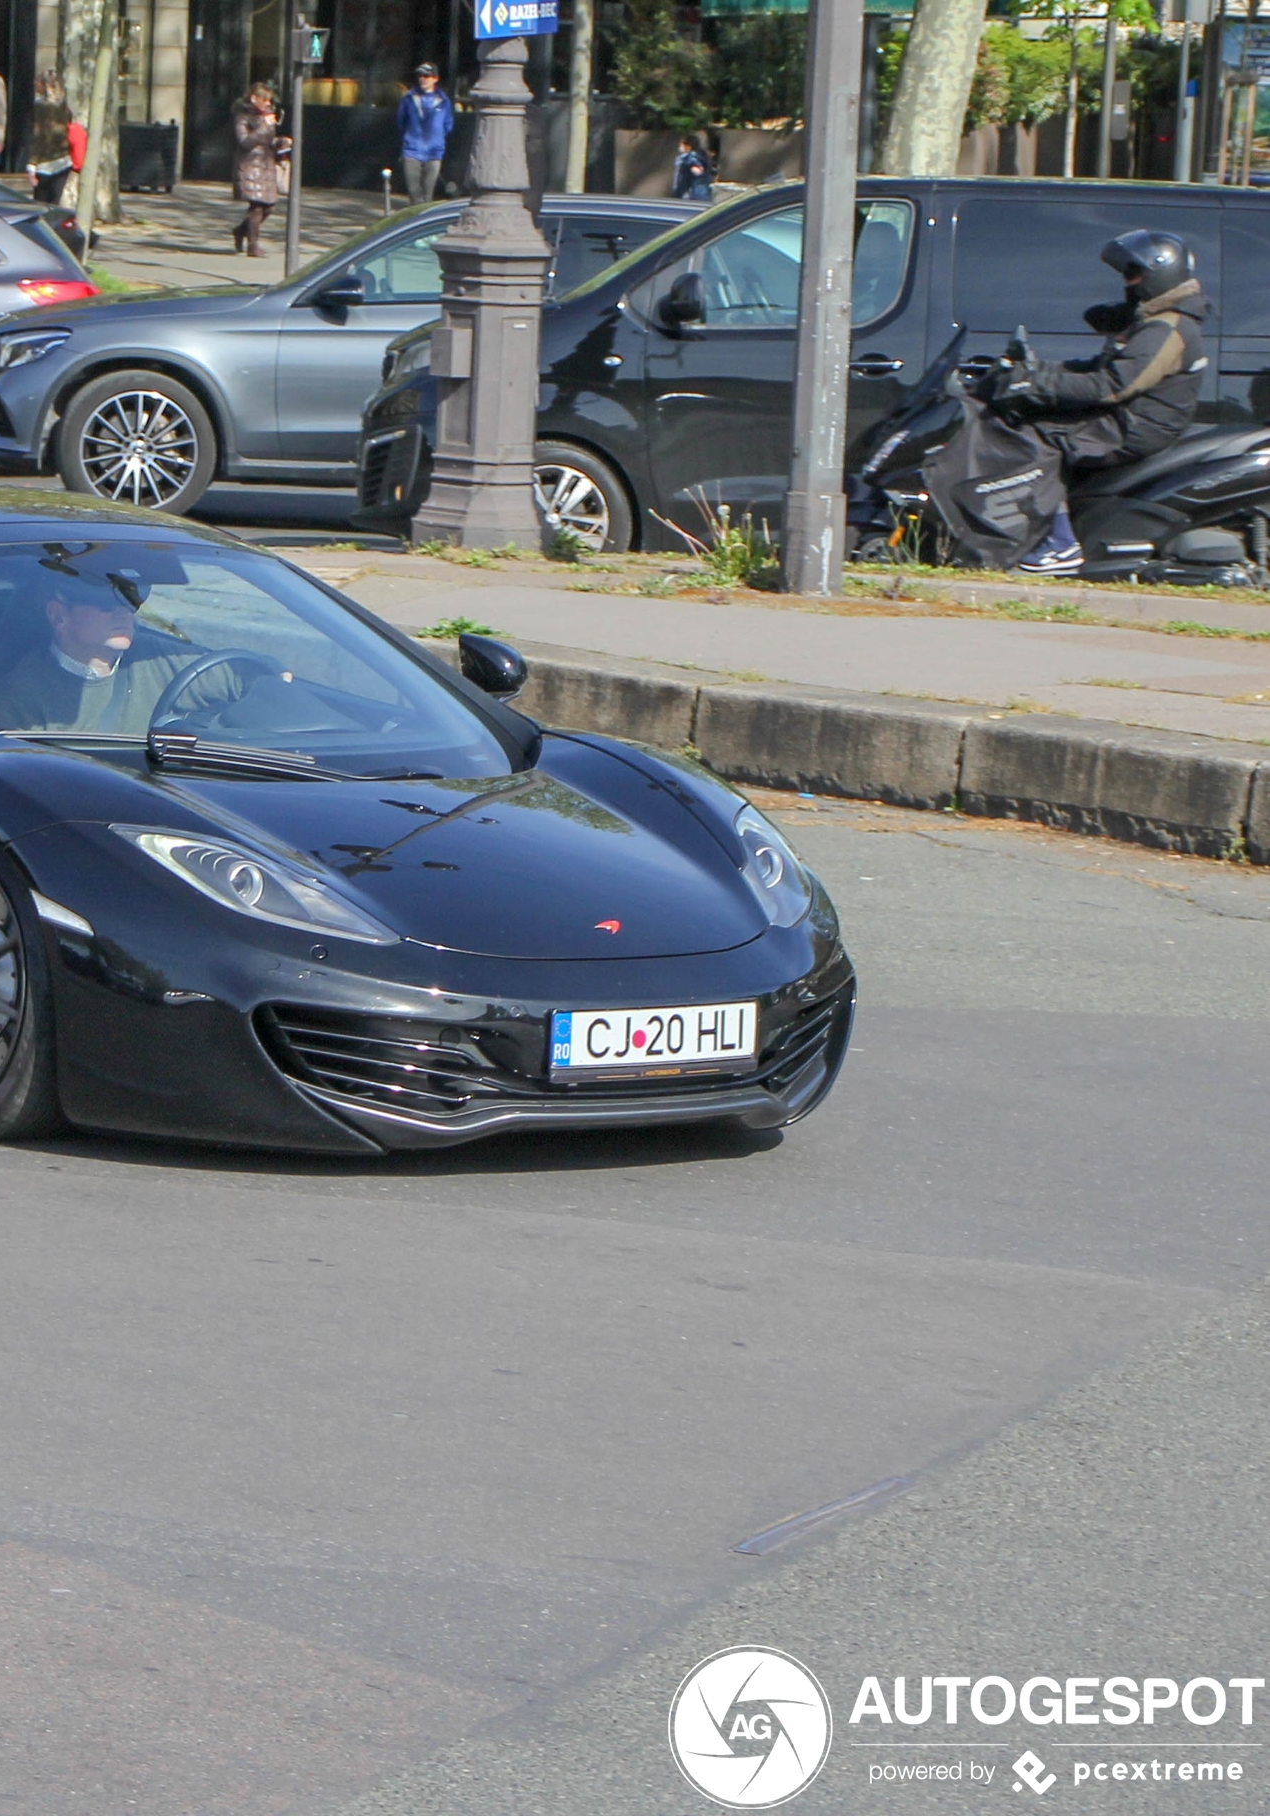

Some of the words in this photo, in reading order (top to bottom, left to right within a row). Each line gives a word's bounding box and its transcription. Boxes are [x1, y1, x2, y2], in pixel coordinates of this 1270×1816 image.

[586, 1016, 632, 1059] CJ
[645, 1013, 685, 1057] 20
[697, 1008, 745, 1053] HLI
[553, 1042, 570, 1060] RO
